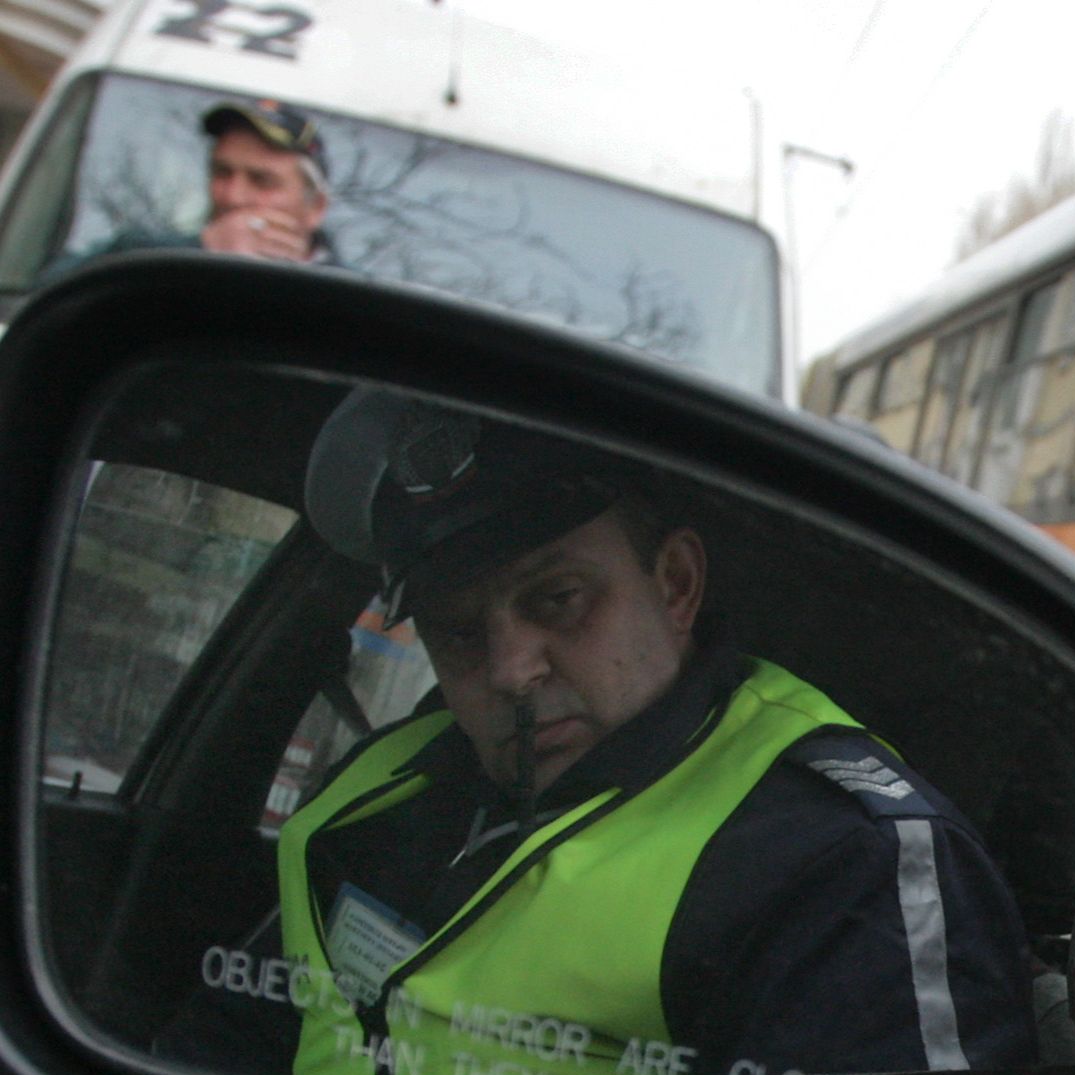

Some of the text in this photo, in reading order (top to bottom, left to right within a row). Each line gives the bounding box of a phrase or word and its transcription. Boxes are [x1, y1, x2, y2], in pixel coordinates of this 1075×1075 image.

[202, 945, 356, 1017] OBJECTS
[387, 984, 422, 1029] IN
[451, 1000, 591, 1067] MIRROR
